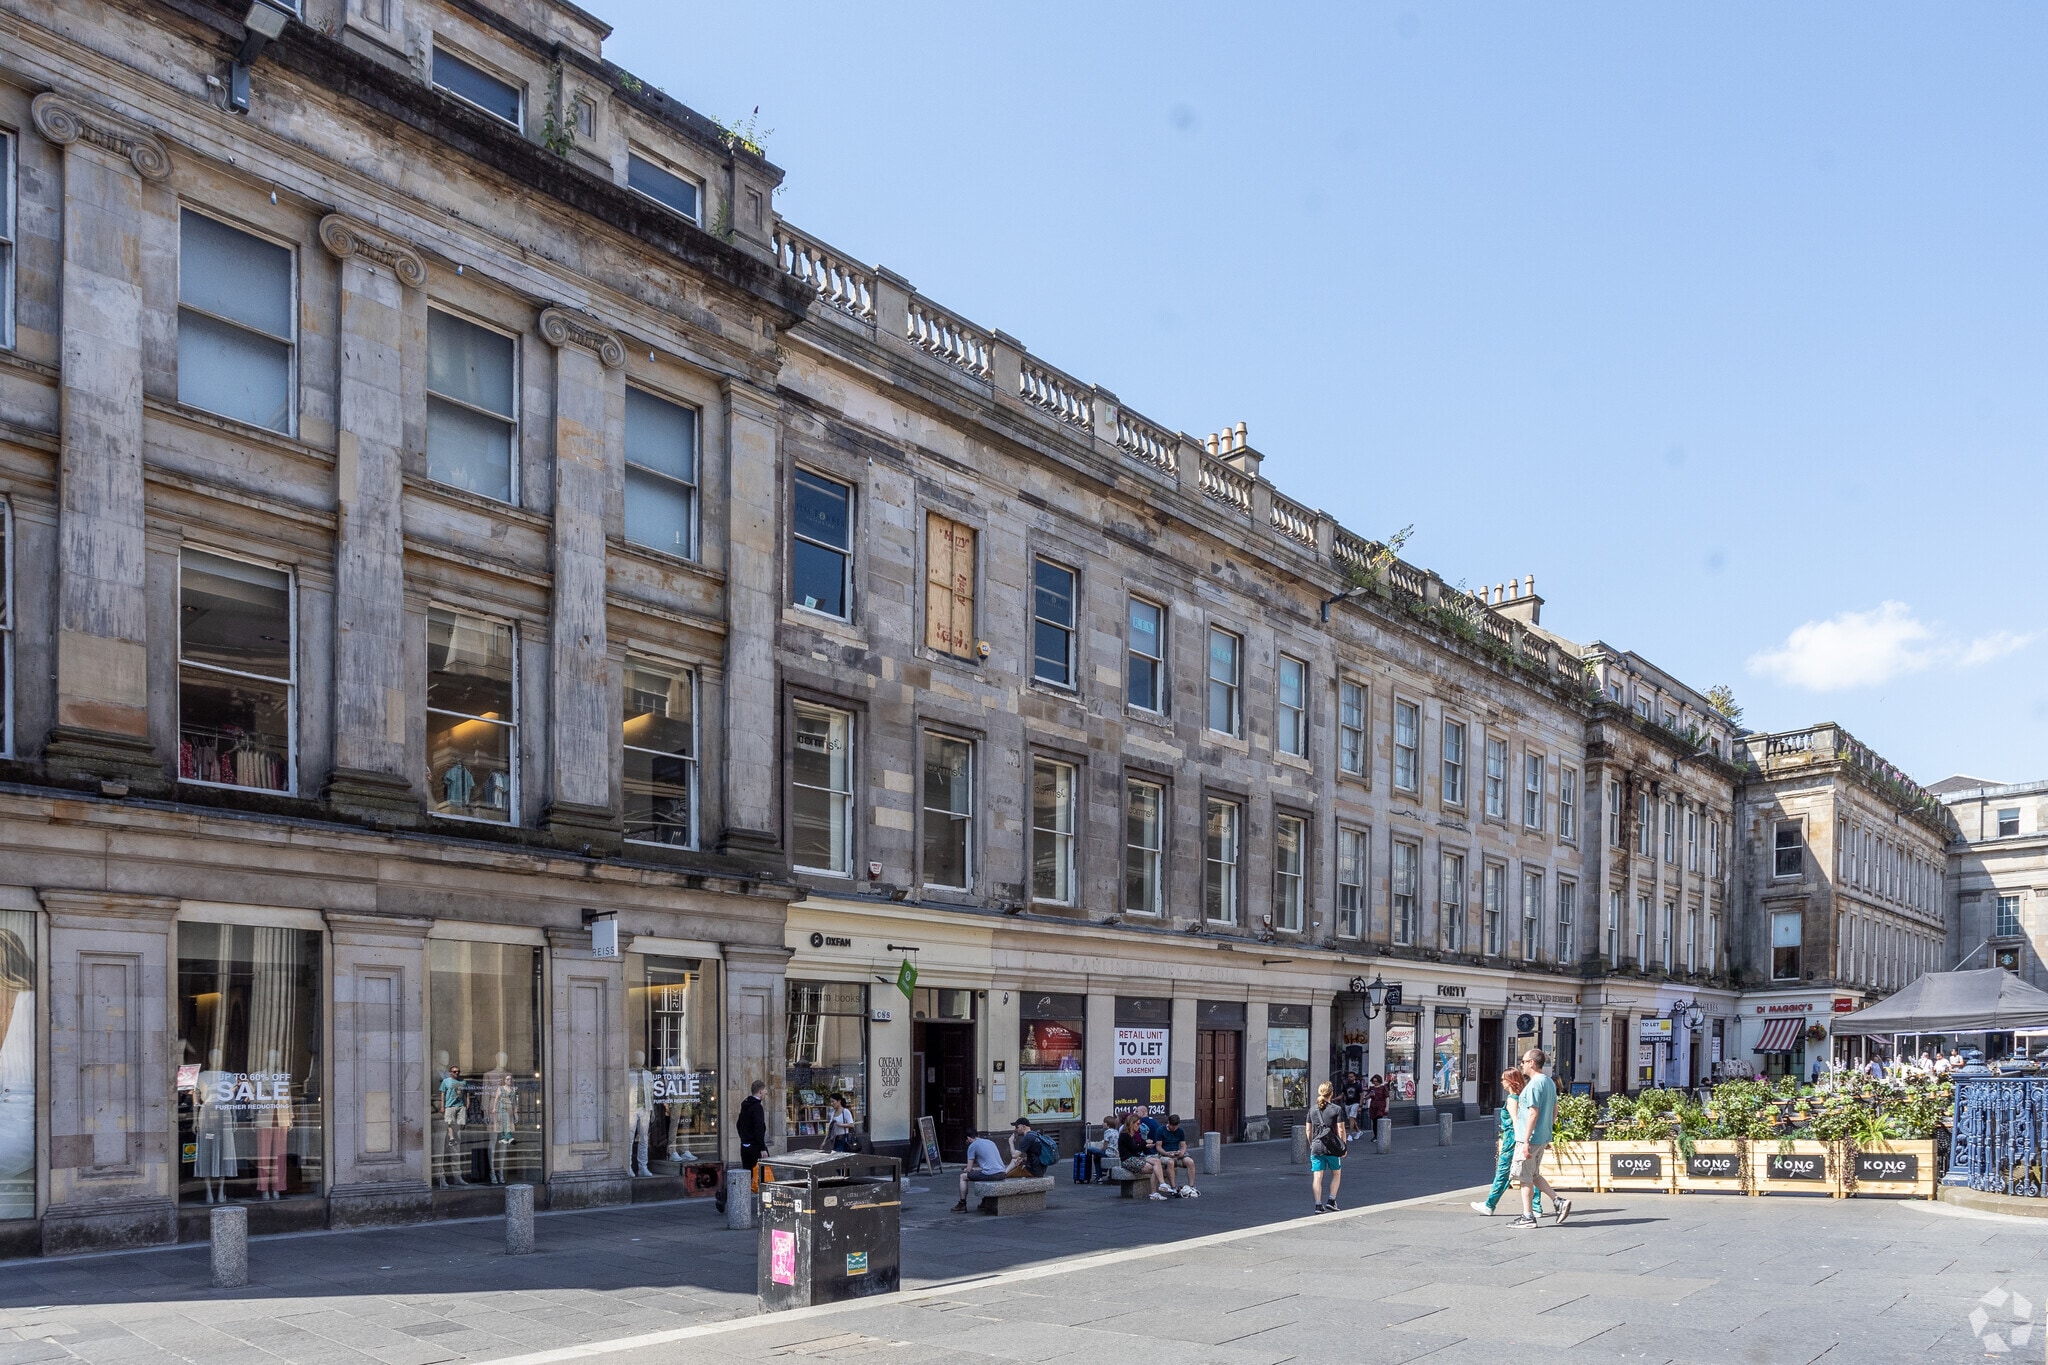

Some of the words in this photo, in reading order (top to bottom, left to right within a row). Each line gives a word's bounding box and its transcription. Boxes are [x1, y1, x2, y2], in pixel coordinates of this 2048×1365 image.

[825, 936, 851, 947] OXFAM
[593, 946, 615, 957] REISS
[1437, 984, 1467, 997] FORTY
[835, 991, 861, 1003] books
[1768, 1003, 1813, 1012] MAGGIO'S
[1119, 1031, 1145, 1039] RETAIL
[1147, 1031, 1163, 1039] UNIT
[1119, 1042, 1137, 1055] TO
[1141, 1042, 1163, 1055] LET
[879, 1057, 902, 1067] OXFAM
[220, 1073, 231, 1081] UP
[234, 1073, 247, 1081] TO
[250, 1073, 270, 1081] 60%
[272, 1073, 291, 1081] OFF
[881, 1068, 900, 1077] BOOK
[882, 1077, 900, 1086] SHOP
[217, 1081, 290, 1102] SALE
[653, 1080, 700, 1096] SALE
[1149, 1105, 1165, 1114] 7342
[1617, 1159, 1652, 1168] KONG
[1693, 1159, 1731, 1168] KONG
[1774, 1160, 1815, 1170] KONG
[1863, 1160, 1907, 1170] KONG
